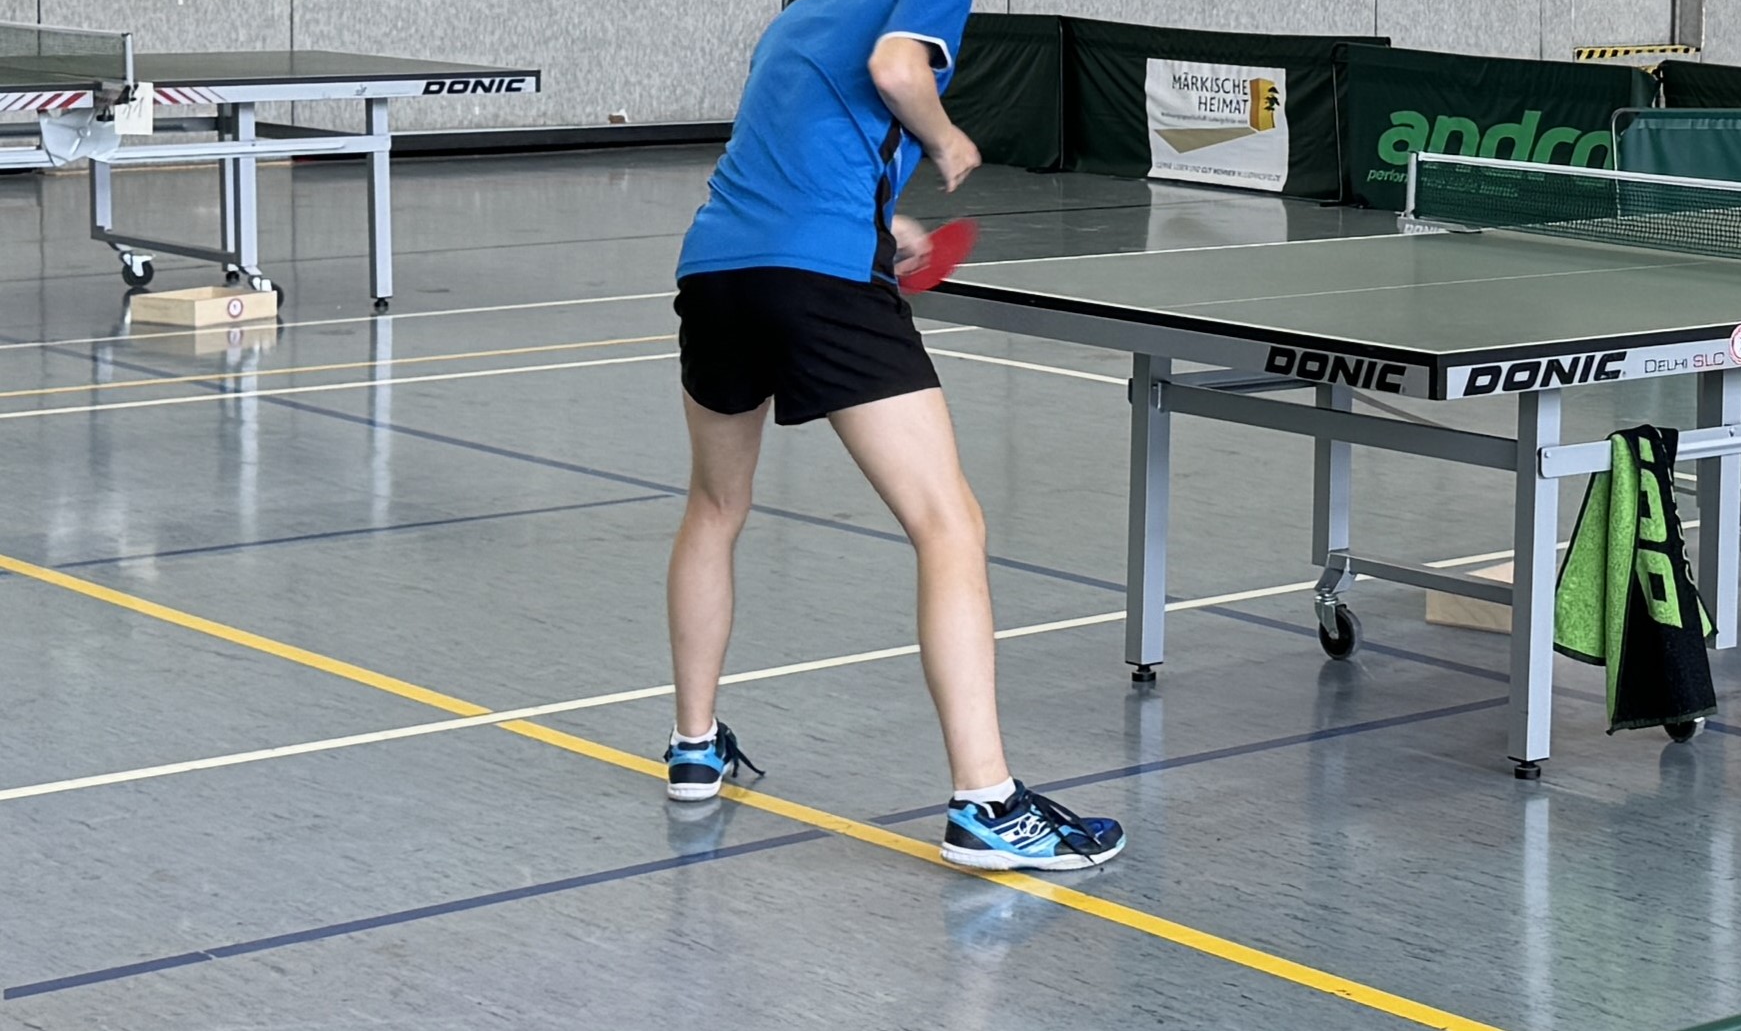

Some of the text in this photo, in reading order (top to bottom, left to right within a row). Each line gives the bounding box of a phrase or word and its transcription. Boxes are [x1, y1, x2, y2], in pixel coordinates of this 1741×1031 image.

[422, 78, 526, 95] DONIC
[1172, 72, 1249, 96] MÄRKISCHE
[1198, 96, 1250, 115] HEIMAT
[1264, 345, 1407, 394] DONIC
[1463, 351, 1627, 396] DONIC
[1693, 352, 1725, 368] SLC
